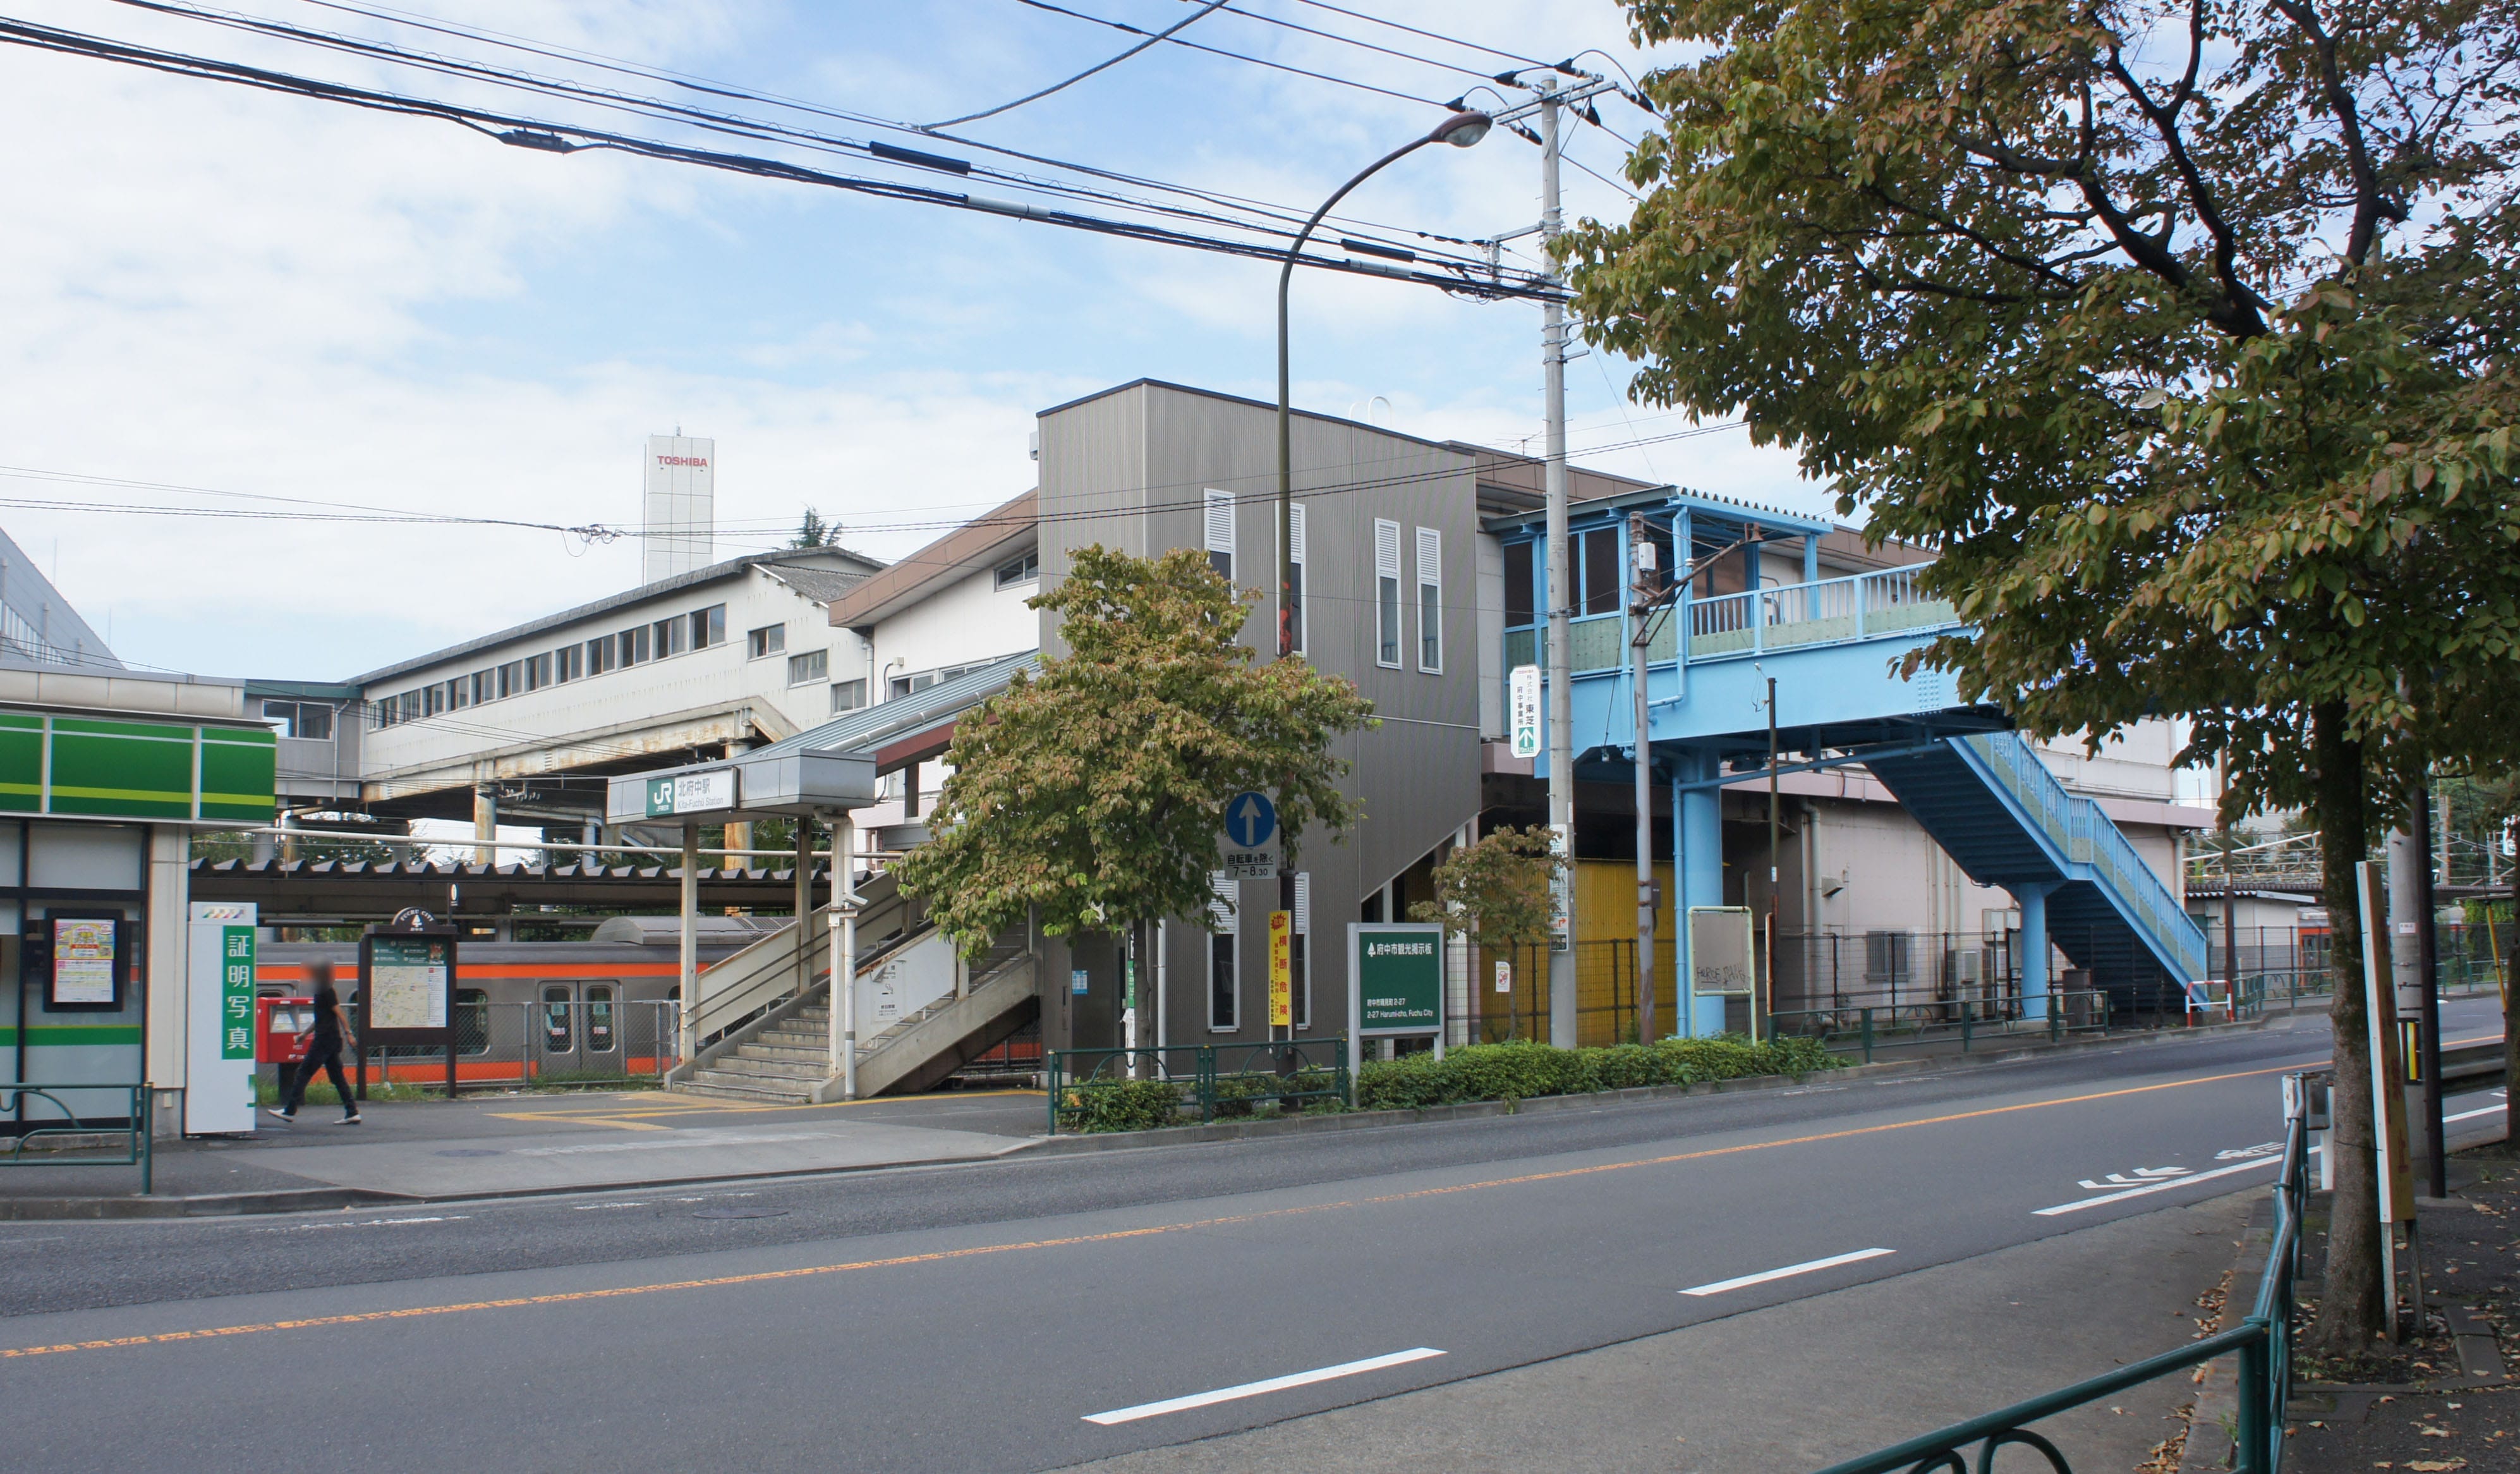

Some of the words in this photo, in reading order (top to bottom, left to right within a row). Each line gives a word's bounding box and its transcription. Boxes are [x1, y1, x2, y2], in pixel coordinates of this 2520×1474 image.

[657, 455, 708, 467] TOSHIBA
[1525, 674, 1535, 726] 株式会社東芝
[653, 782, 672, 805] JR
[678, 778, 711, 798] 北府中駅
[705, 796, 724, 807] Station
[1228, 853, 1274, 865] 自転車を除く
[400, 908, 420, 922] FUCHU
[421, 910, 435, 922] CITY
[1376, 942, 1433, 956] 府中市観光掲示板
[1278, 935, 1288, 1016] 横断危険
[227, 935, 251, 1050] 証明写真
[1408, 1009, 1423, 1017] Fuchu
[1423, 1009, 1434, 1017] City
